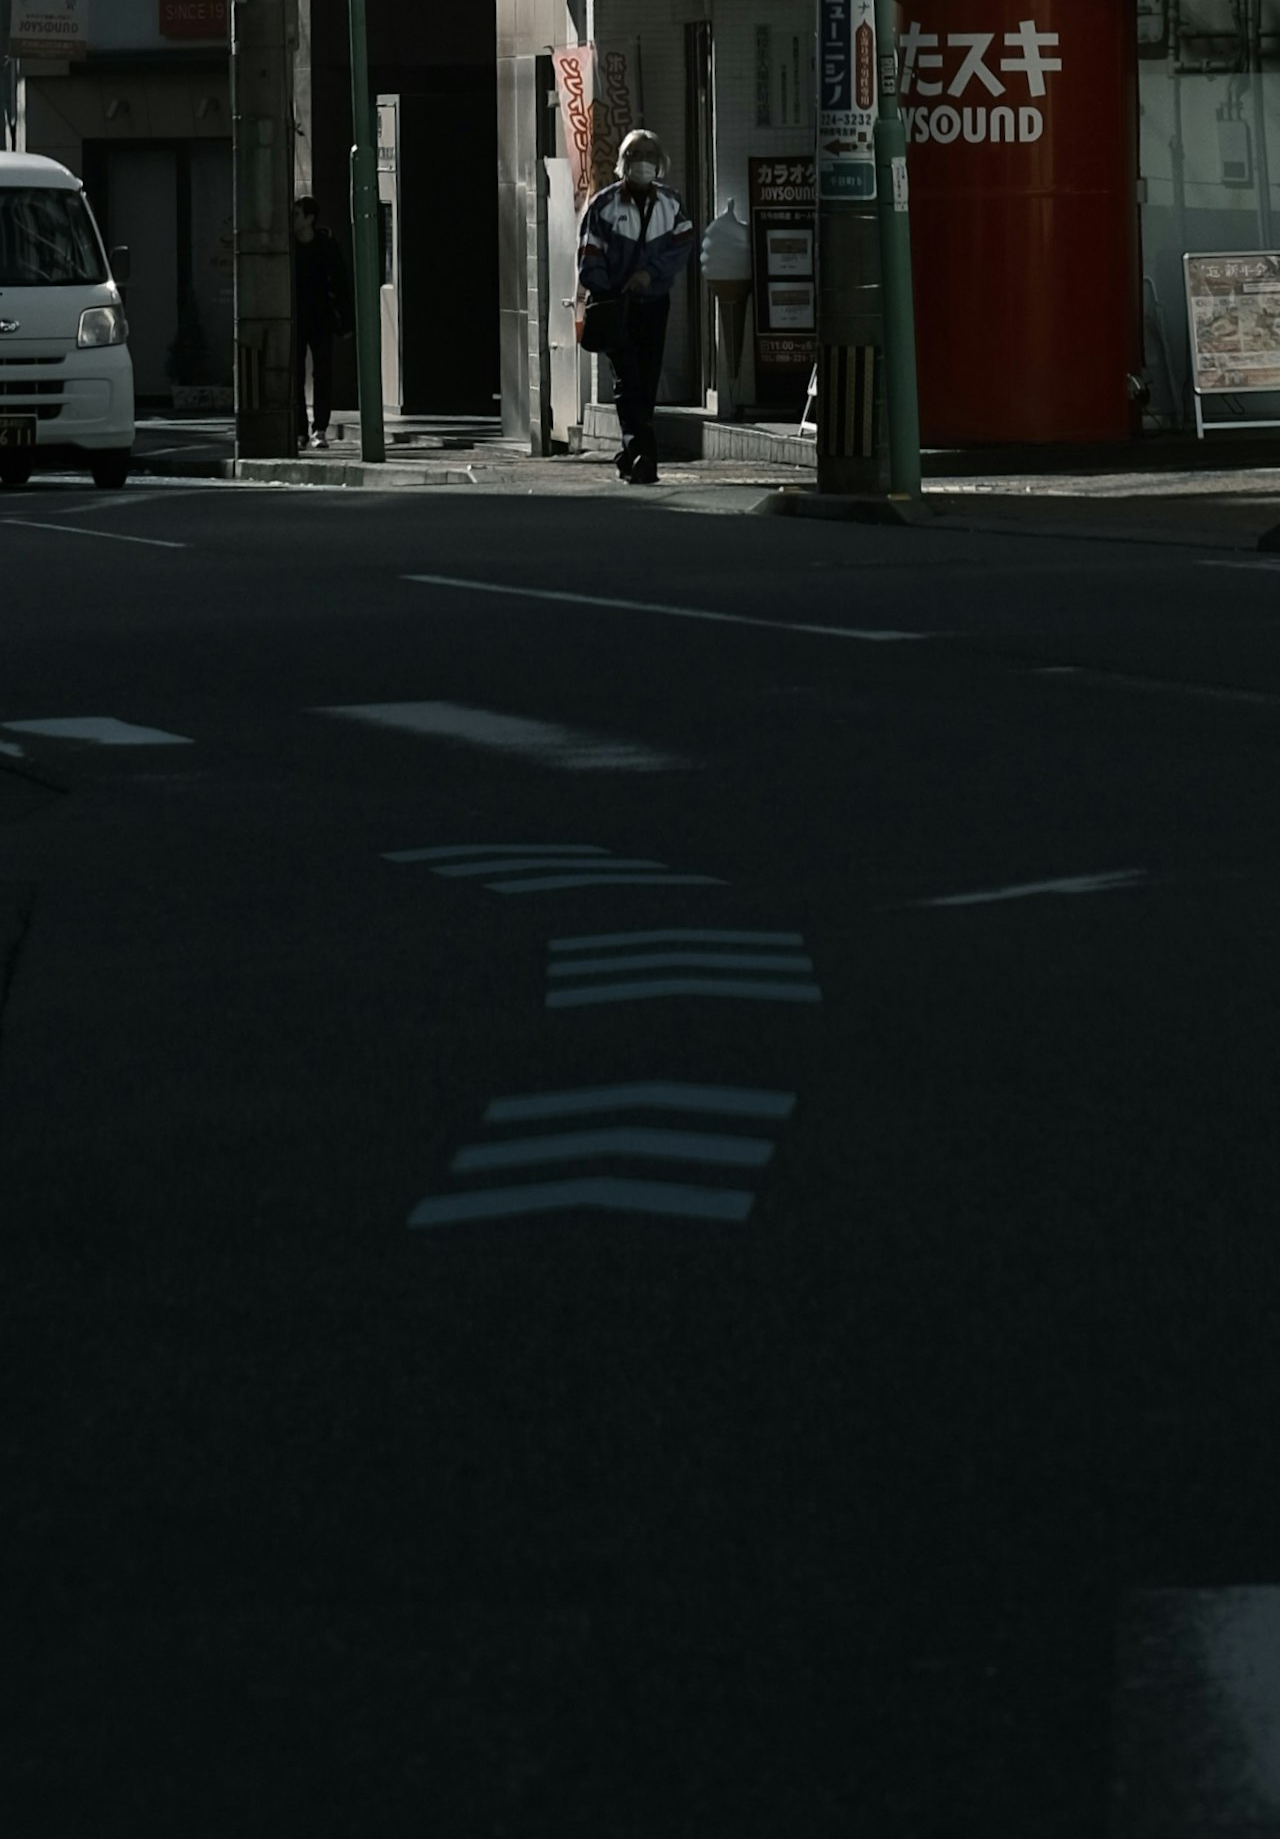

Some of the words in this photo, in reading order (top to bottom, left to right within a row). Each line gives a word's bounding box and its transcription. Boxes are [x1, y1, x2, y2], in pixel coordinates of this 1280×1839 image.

[165, 2, 206, 20] SINCE
[18, 20, 79, 34] JOYSOUND
[899, 19, 1063, 98] たスキ
